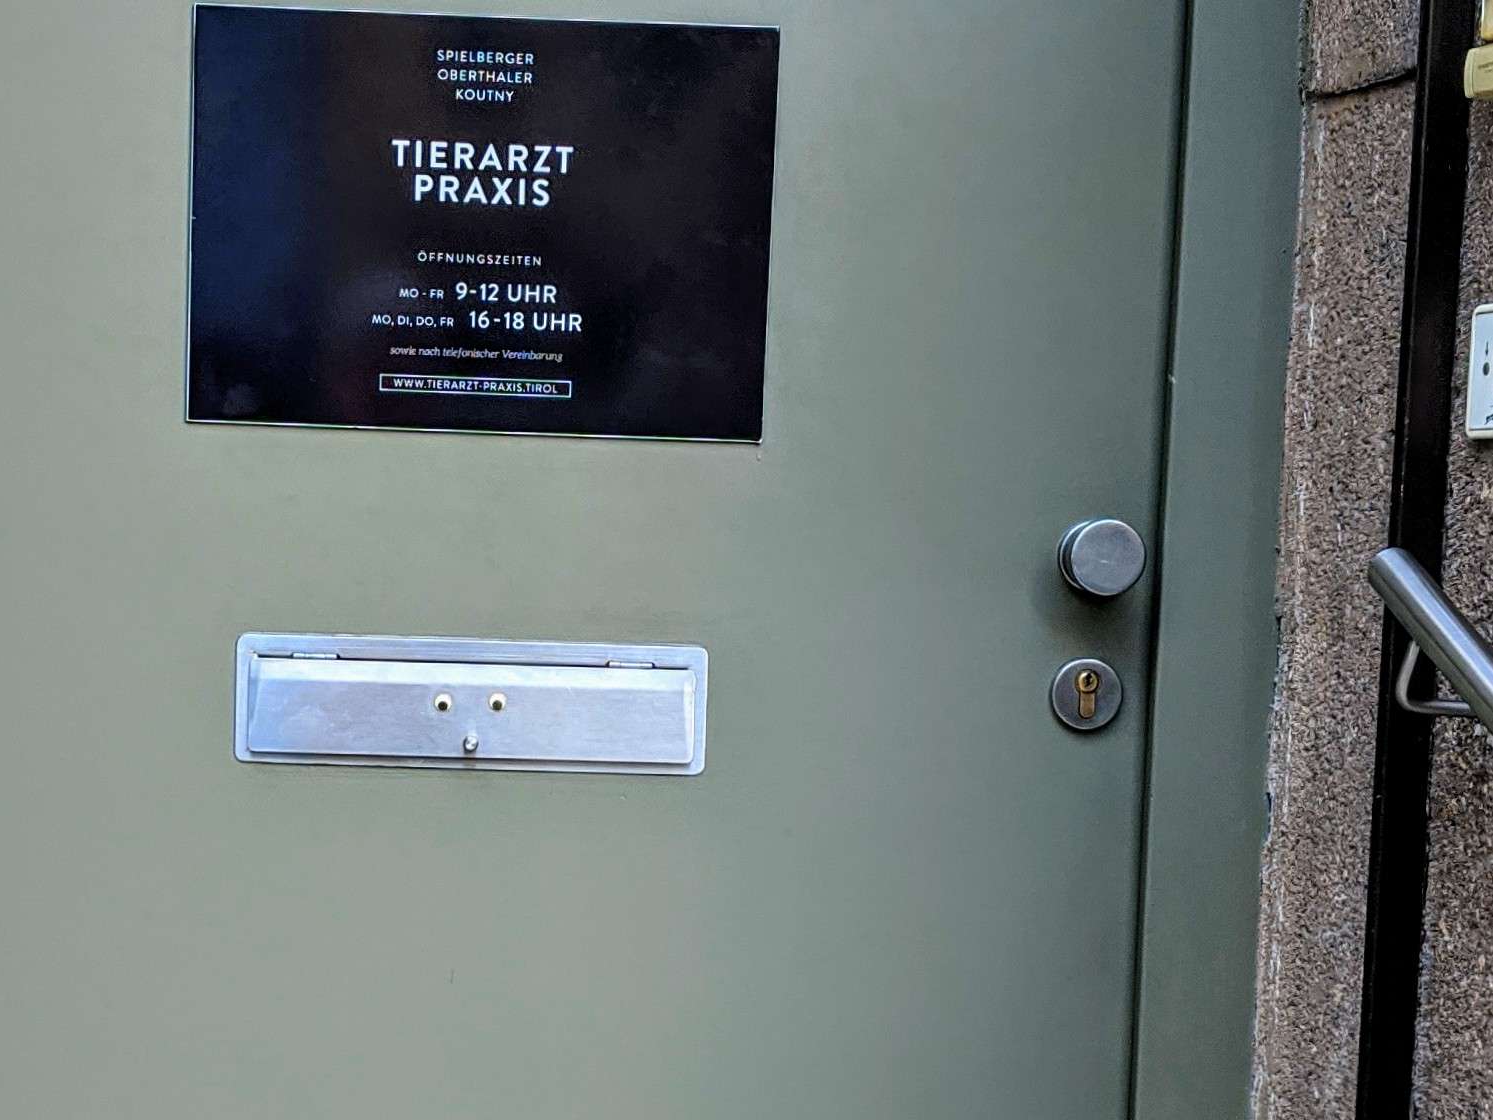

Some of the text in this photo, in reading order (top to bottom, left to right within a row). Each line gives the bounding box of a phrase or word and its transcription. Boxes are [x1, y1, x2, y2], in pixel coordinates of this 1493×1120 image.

[436, 49, 534, 65] SPIELBERGER
[436, 68, 533, 84] OBERTHALER
[455, 88, 515, 103] KOUTNY
[391, 138, 575, 175] TIERARZT
[414, 173, 551, 207] PRAXIS
[417, 249, 542, 266] ÖFFNUNGSZEITEN
[398, 287, 419, 299] MO
[429, 288, 445, 300] FR
[455, 281, 500, 302] 9-12
[507, 283, 557, 304] UHR
[371, 313, 395, 327] MO,
[397, 314, 413, 328] DI,
[415, 315, 437, 329] DO,
[439, 316, 455, 328] FR
[532, 311, 583, 333] UHR
[389, 345, 417, 356] sowie
[501, 349, 564, 364] Vereinbarung
[392, 378, 558, 394] WWW.TIERARZT-PRAXIS.TIROL
